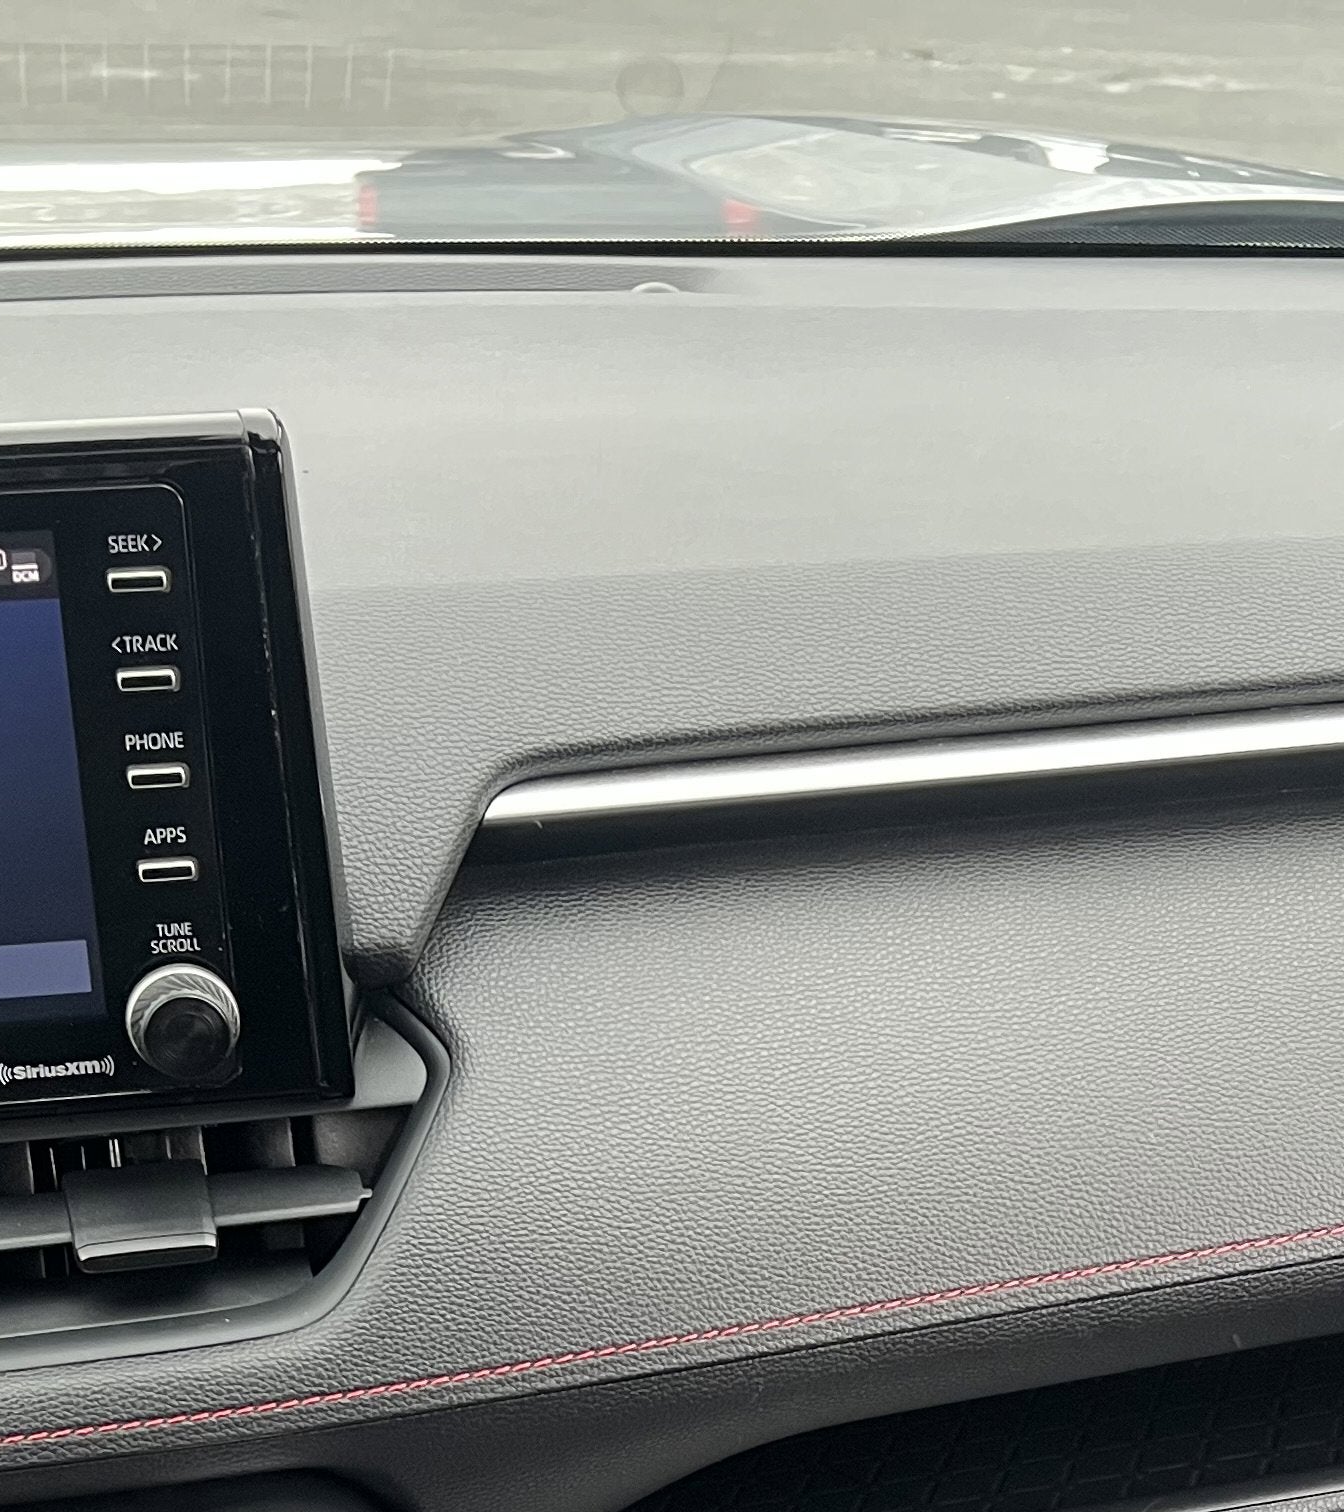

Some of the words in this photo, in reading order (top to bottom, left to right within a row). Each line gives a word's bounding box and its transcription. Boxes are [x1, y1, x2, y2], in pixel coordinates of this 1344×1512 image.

[108, 534, 149, 554] SEEK
[122, 634, 179, 654] TRACK
[125, 731, 185, 751] PHONE
[144, 827, 187, 845] APPS
[157, 922, 193, 938] TUNE
[150, 937, 201, 955] SCROLL
